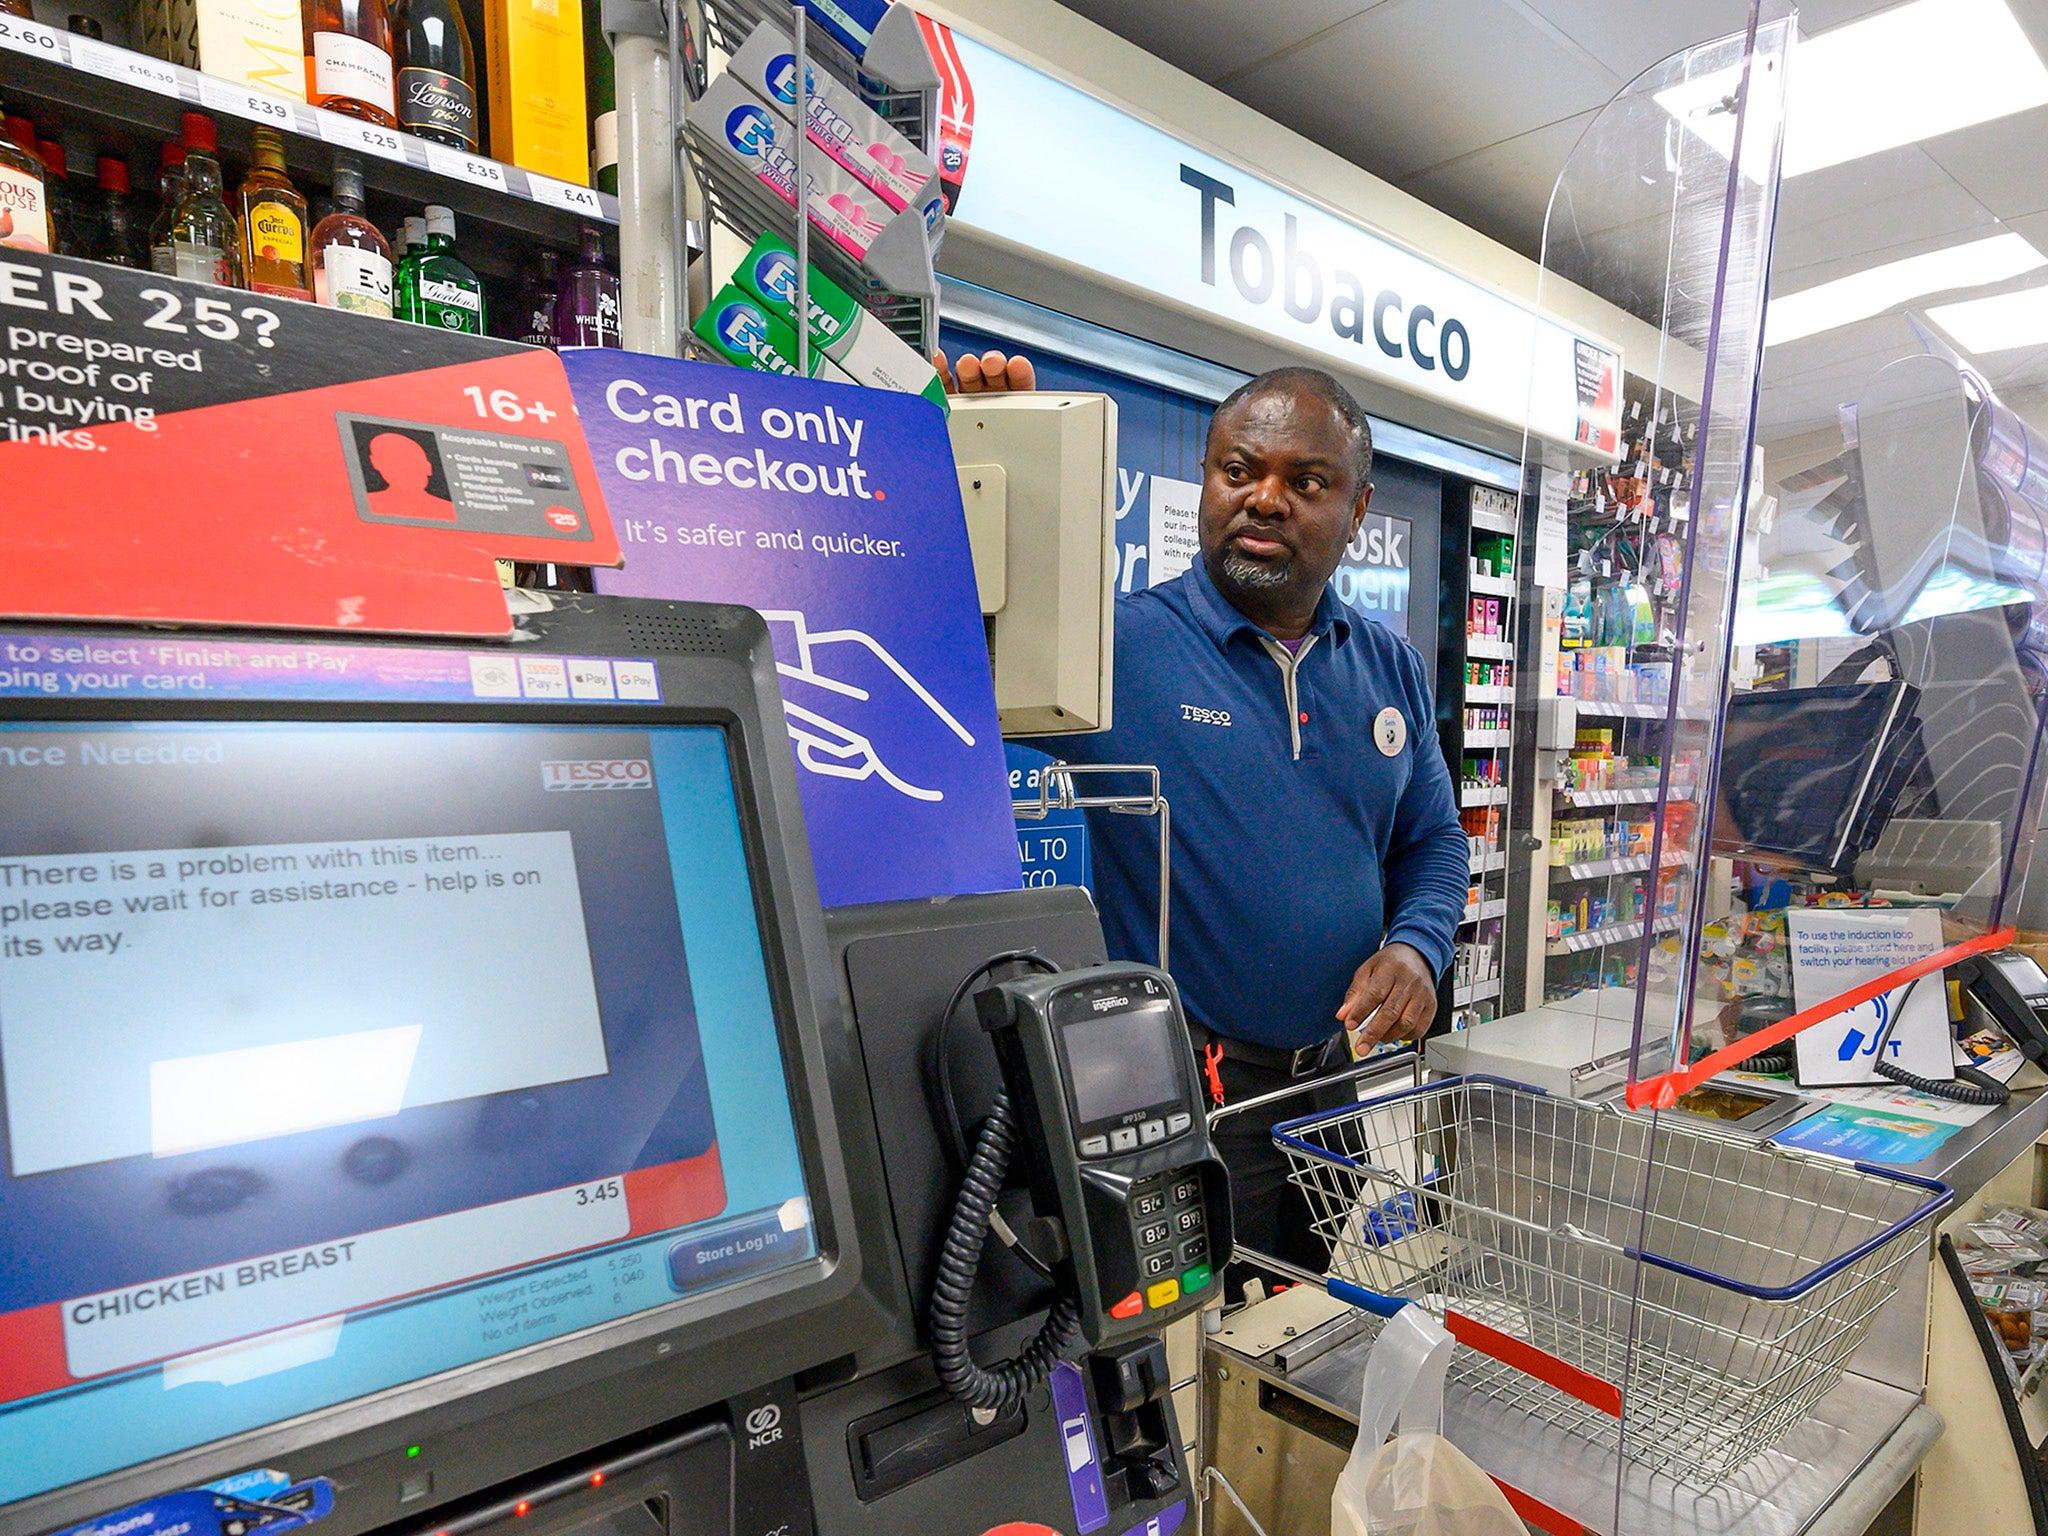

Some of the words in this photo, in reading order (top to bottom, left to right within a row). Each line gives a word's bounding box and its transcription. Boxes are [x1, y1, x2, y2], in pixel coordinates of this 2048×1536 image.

[129, 65, 174, 84] £16.30
[325, 59, 387, 82] CHAMPAGNE
[248, 98, 287, 118] £39
[407, 82, 473, 119] Lanson
[431, 109, 459, 122] 1760
[362, 131, 398, 149] £25
[467, 162, 499, 180] £35
[763, 164, 794, 194] WHITE
[564, 189, 594, 206] £41
[258, 219, 295, 237] Cuervo
[262, 235, 293, 246] ESPECIAL
[1180, 163, 1471, 382] Tobacco
[139, 289, 280, 348] 25?
[8, 326, 203, 373] prepared
[110, 371, 153, 395] of
[15, 385, 159, 432] buying
[463, 385, 558, 424] 16+
[605, 379, 745, 434] Card
[760, 405, 864, 457] only
[441, 433, 498, 449] Acceptable
[499, 440, 529, 453] forms
[530, 446, 541, 454] of
[542, 446, 556, 456] ID:
[454, 453, 483, 464] Cards
[482, 456, 519, 470] bearing
[615, 438, 886, 501] checkout.
[461, 481, 523, 496] Photographic
[464, 490, 499, 503] Driving
[466, 500, 509, 512] Passport
[1164, 505, 1190, 518] Please
[1164, 521, 1178, 530] our
[625, 518, 668, 543] It’s
[676, 523, 746, 548] safer
[755, 529, 804, 551] and
[811, 531, 906, 557] quicker.
[1163, 548, 1181, 559] with
[7, 644, 40, 664] to
[50, 645, 141, 666] select
[249, 651, 299, 670] and
[524, 664, 560, 673] TESCO
[66, 672, 133, 693] your
[140, 672, 214, 691] card.
[585, 673, 607, 686] Pay
[633, 675, 651, 688] Pay
[1180, 704, 1231, 721] TESCO
[81, 742, 225, 766] Needed
[544, 759, 649, 783] TESCO
[1040, 838, 1067, 861] TO
[0, 863, 98, 888] There
[110, 860, 137, 881] is
[148, 862, 167, 879] a
[178, 852, 297, 882] problem
[306, 848, 363, 870] with
[371, 845, 418, 866] this
[426, 843, 502, 864] item...
[1, 898, 113, 928] please
[123, 889, 189, 914] wait
[200, 886, 240, 909] for
[250, 878, 398, 905] assistance
[424, 871, 478, 894] help
[484, 869, 505, 888] is
[512, 869, 542, 886] on
[3, 934, 44, 958] its
[54, 931, 132, 955] way.
[1797, 930, 1809, 940] To
[1811, 932, 1828, 941] use
[1830, 931, 1846, 941] the
[1848, 930, 1891, 941] induction
[1893, 930, 1914, 944] loop
[1833, 945, 1863, 957] please
[1866, 943, 1891, 953] stand
[1893, 942, 1915, 952] here
[1917, 941, 1934, 951] and
[1800, 957, 1830, 967] switch
[1832, 958, 1852, 968] your
[1855, 956, 1890, 968] hearing
[1891, 956, 1905, 965] aid
[1092, 997, 1129, 1012] ingenico
[1888, 1040, 1901, 1057] T
[575, 1181, 620, 1207] 3.45
[695, 1245, 734, 1266] Store
[736, 1239, 762, 1257] Log
[763, 1232, 779, 1247] In
[71, 1271, 226, 1325] CHICKEN
[236, 1241, 356, 1288] BREAST
[477, 1283, 525, 1307] Weight
[528, 1268, 589, 1294] Expected
[479, 1302, 529, 1324] Weight
[532, 1284, 593, 1310] Observed
[504, 1320, 519, 1337] of
[522, 1313, 558, 1333] items
[749, 1427, 784, 1450] NCR
